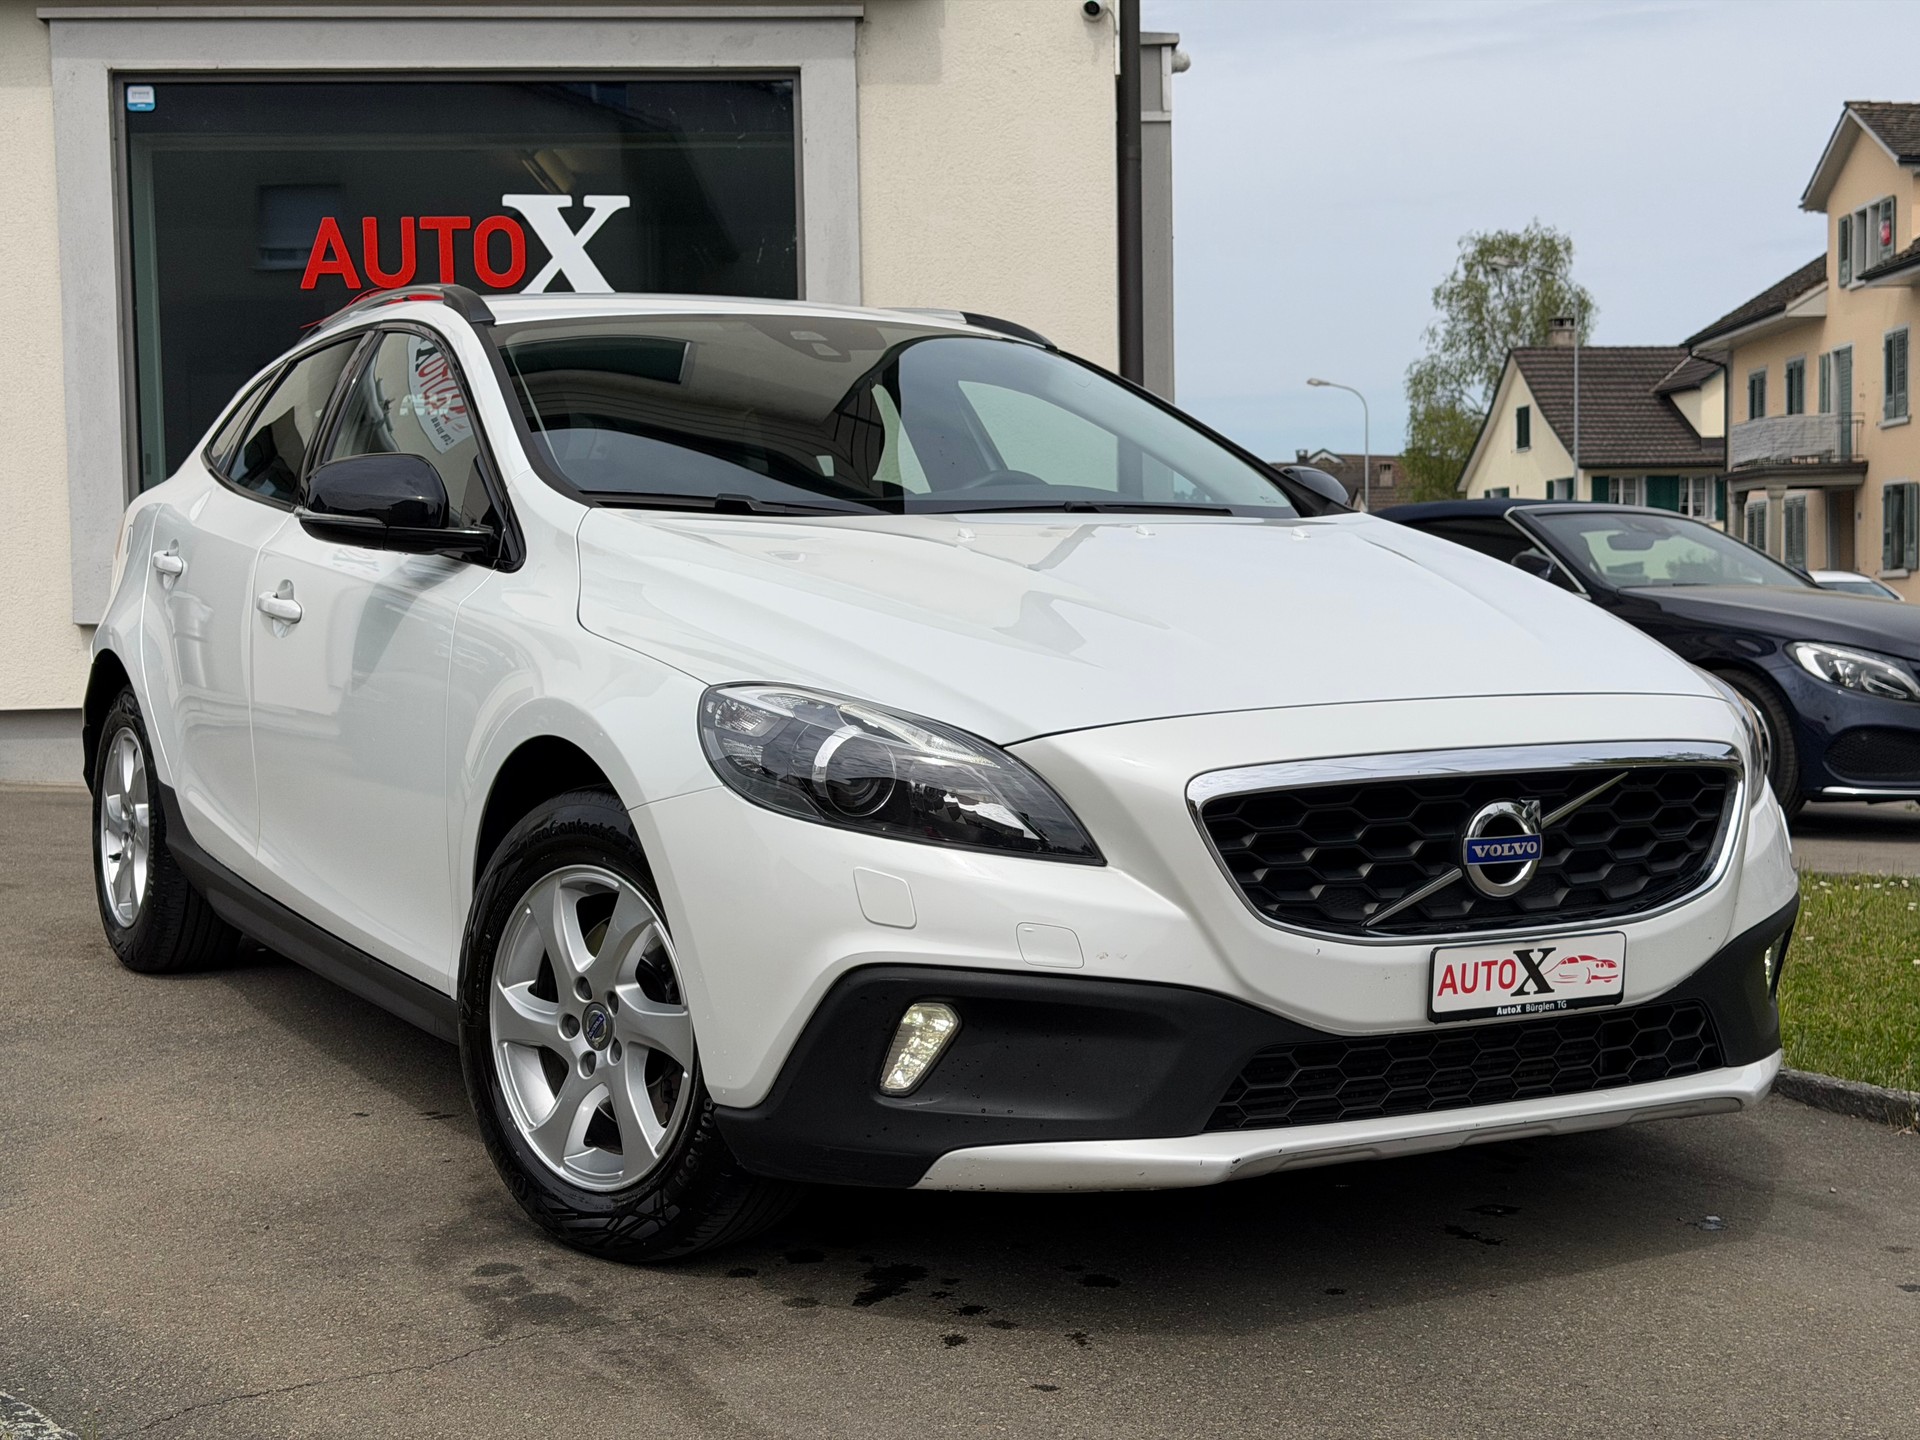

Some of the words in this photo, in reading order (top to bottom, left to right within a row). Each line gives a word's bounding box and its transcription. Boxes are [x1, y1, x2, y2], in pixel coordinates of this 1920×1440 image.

[300, 194, 630, 294] AUTOX
[1472, 841, 1538, 858] VOLVO
[1437, 947, 1556, 997] AUTOX
[1496, 1005, 1521, 1016] AutoX
[1525, 1002, 1555, 1013] Bürglen
[1556, 1000, 1567, 1009] TG
